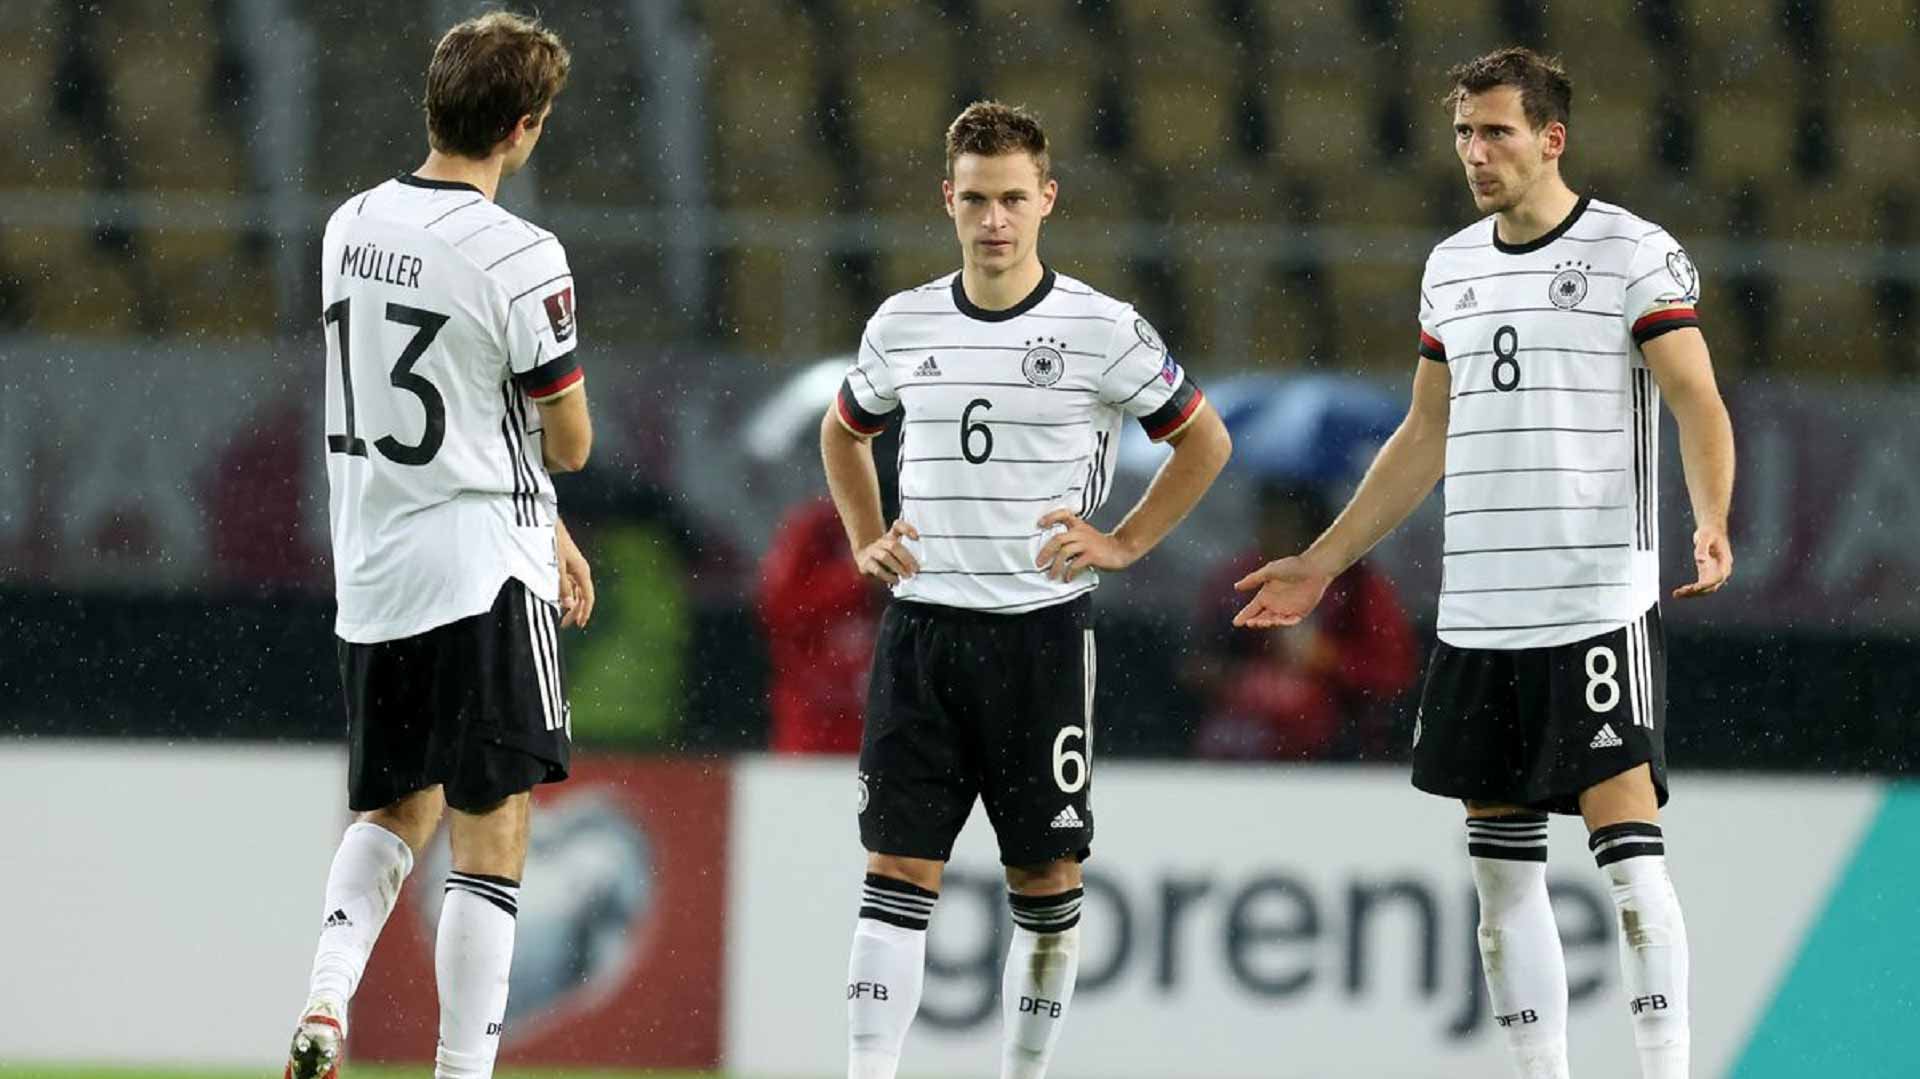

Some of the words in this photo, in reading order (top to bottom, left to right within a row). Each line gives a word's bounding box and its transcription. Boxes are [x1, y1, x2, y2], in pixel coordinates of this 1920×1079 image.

[340, 243, 423, 289] MÜLLER
[1492, 325, 1521, 391] 8
[324, 297, 451, 466] 13
[913, 368, 942, 377] adidas
[960, 398, 993, 465] 6
[1584, 646, 1620, 713] 8
[1589, 736, 1623, 749] adidas
[1052, 725, 1087, 793] 6
[1050, 817, 1084, 829] adidas
[848, 981, 889, 1001] DFB
[1019, 997, 1062, 1018] DFB
[1630, 994, 1668, 1015] DFB
[1494, 1009, 1538, 1027] DFB
